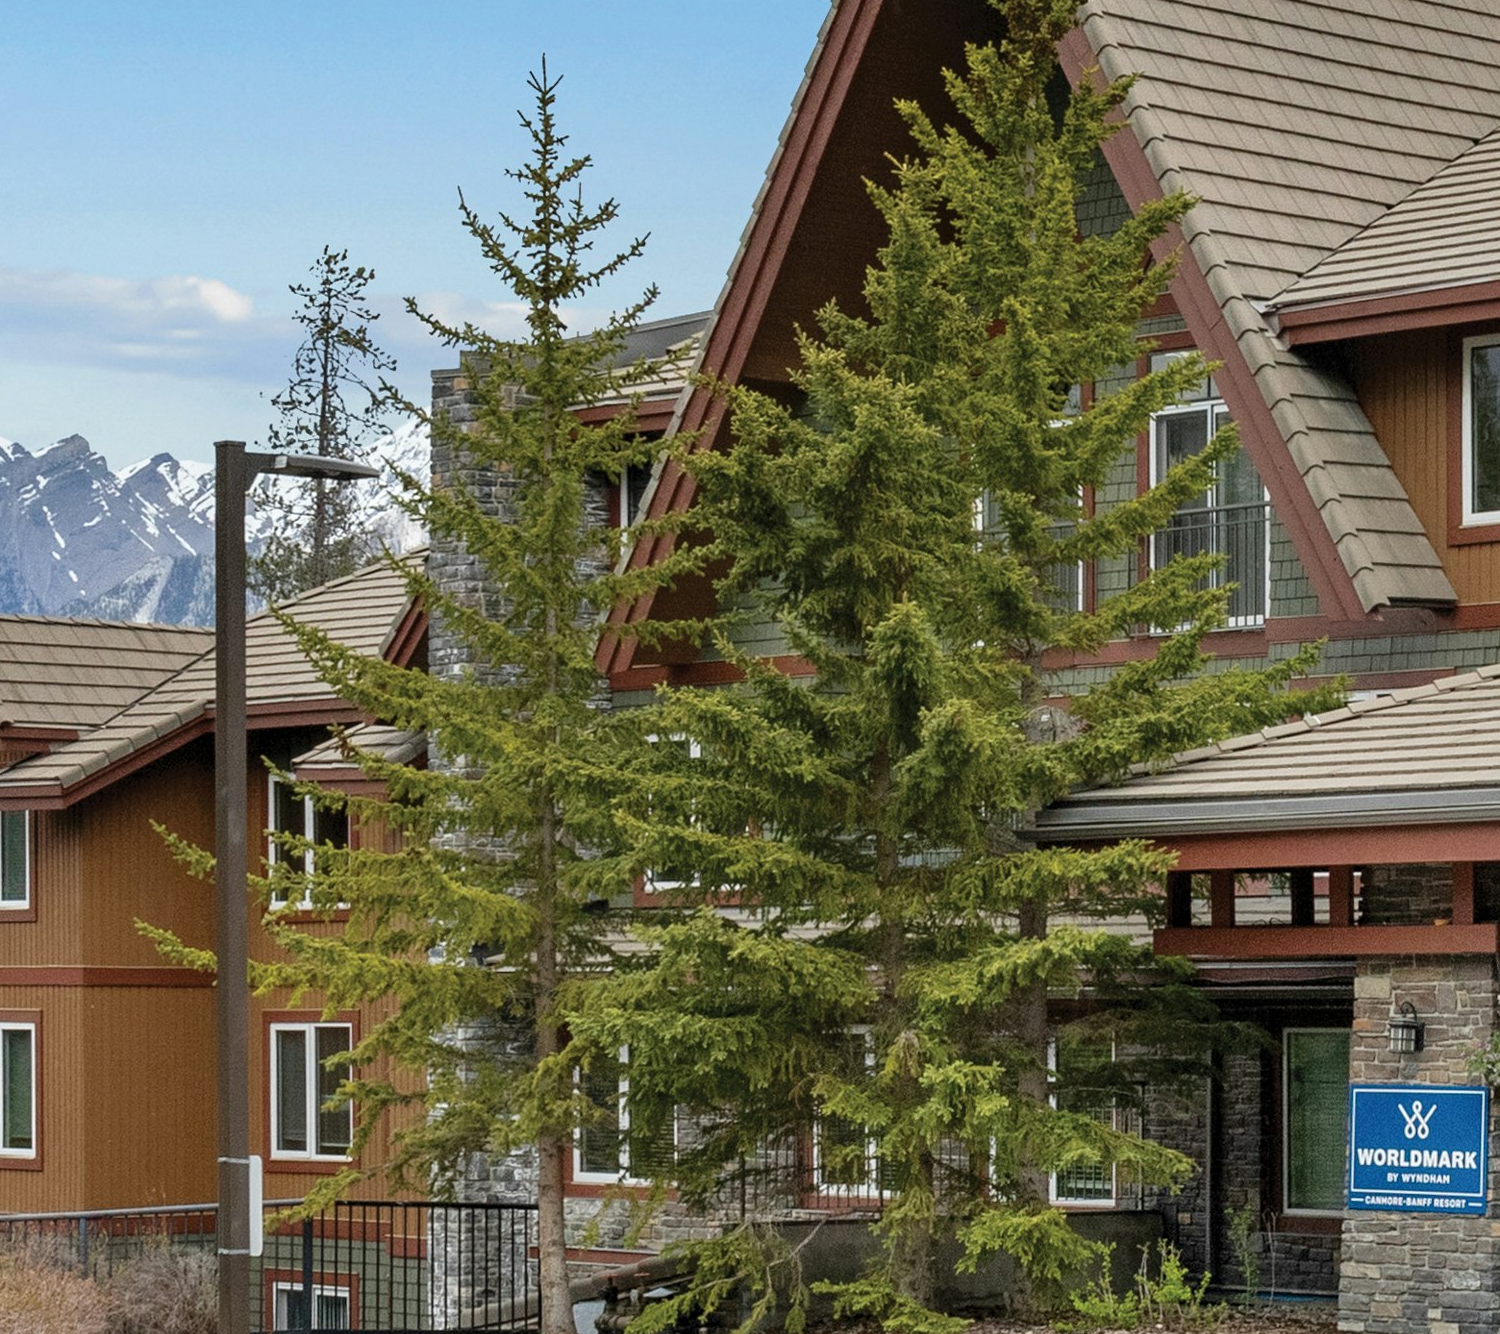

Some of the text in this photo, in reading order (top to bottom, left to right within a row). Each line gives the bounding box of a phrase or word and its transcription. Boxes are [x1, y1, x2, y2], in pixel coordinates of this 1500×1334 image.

[1357, 1148, 1477, 1169] WORLDMARK
[1386, 1172, 1450, 1184] BY WYNDHAM
[1433, 1198, 1467, 1208] RESORT
